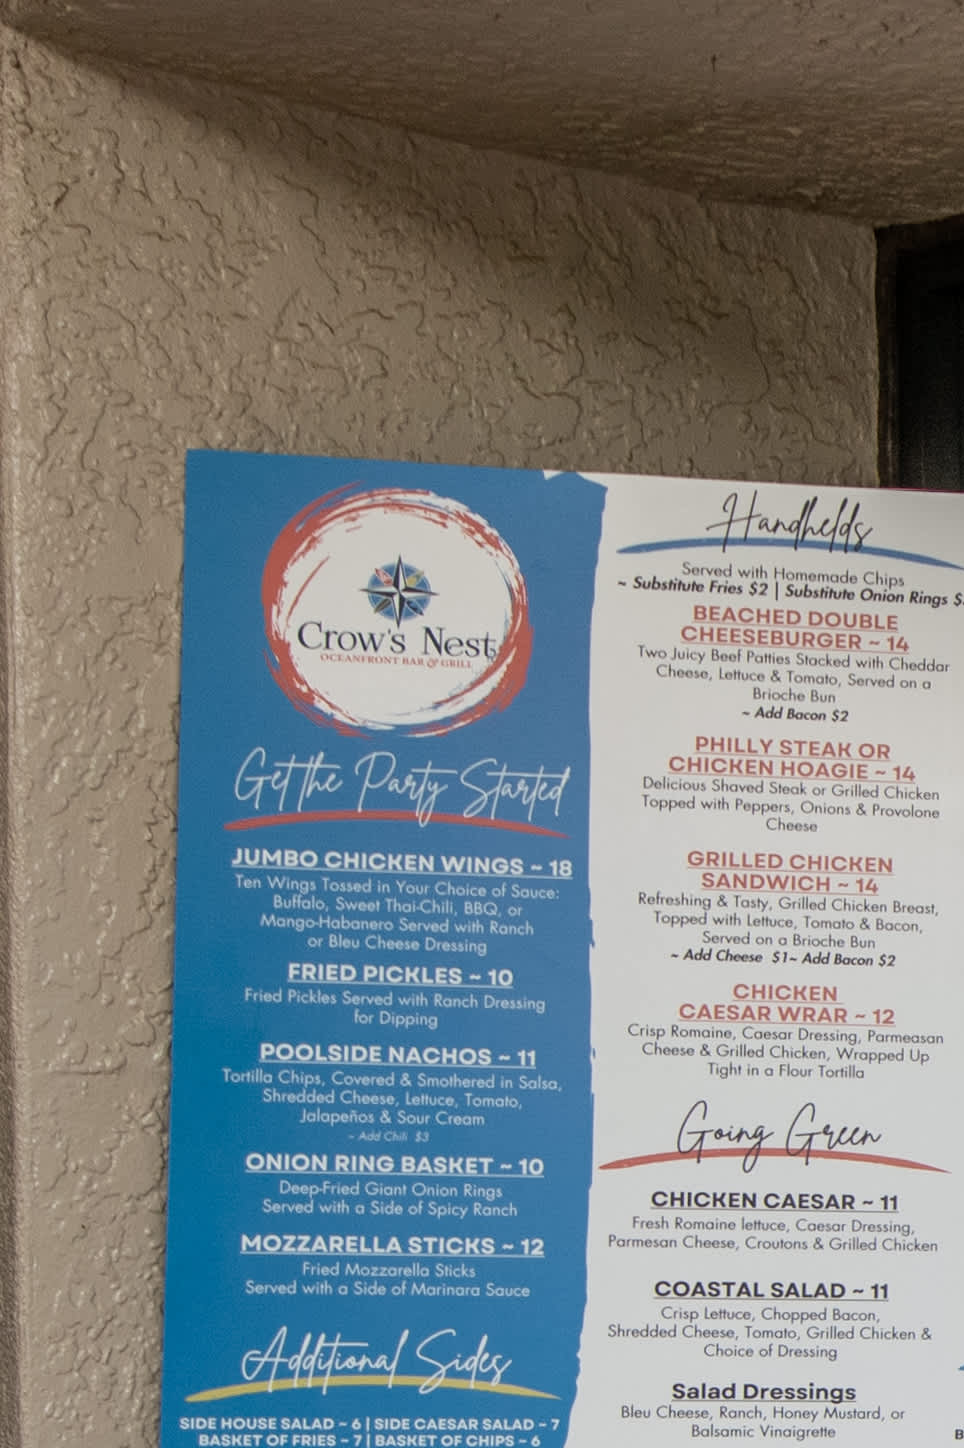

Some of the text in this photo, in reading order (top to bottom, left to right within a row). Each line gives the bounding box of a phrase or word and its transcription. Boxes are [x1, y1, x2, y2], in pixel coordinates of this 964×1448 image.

[706, 490, 873, 554] Handhelds
[682, 562, 905, 588] Served with Homemade Chips
[298, 621, 497, 660] Crow's Nest
[681, 626, 862, 650] CHEESEBURGER
[887, 636, 909, 652] 14
[321, 653, 472, 669] OCEANFRONT BAR & GRILL
[235, 747, 570, 827] Get the Party Started
[232, 848, 319, 867] JUMBO
[325, 851, 434, 872] CHICKEN
[441, 855, 523, 875] WINGS
[550, 859, 572, 877] 18
[288, 963, 357, 983] FRIED
[369, 965, 461, 985] PICKLES
[489, 968, 513, 986] 10
[679, 1004, 771, 1022] CAESAR
[873, 1009, 895, 1025] 12
[300, 1108, 485, 1127] Jalapeños & Sour Cream
[358, 1131, 381, 1142] Add
[677, 1100, 882, 1174] Going Green
[241, 1325, 513, 1396] Additional Sides
[621, 1404, 905, 1423] Bleu Cheese, Ranch, Honey Mustard, or
